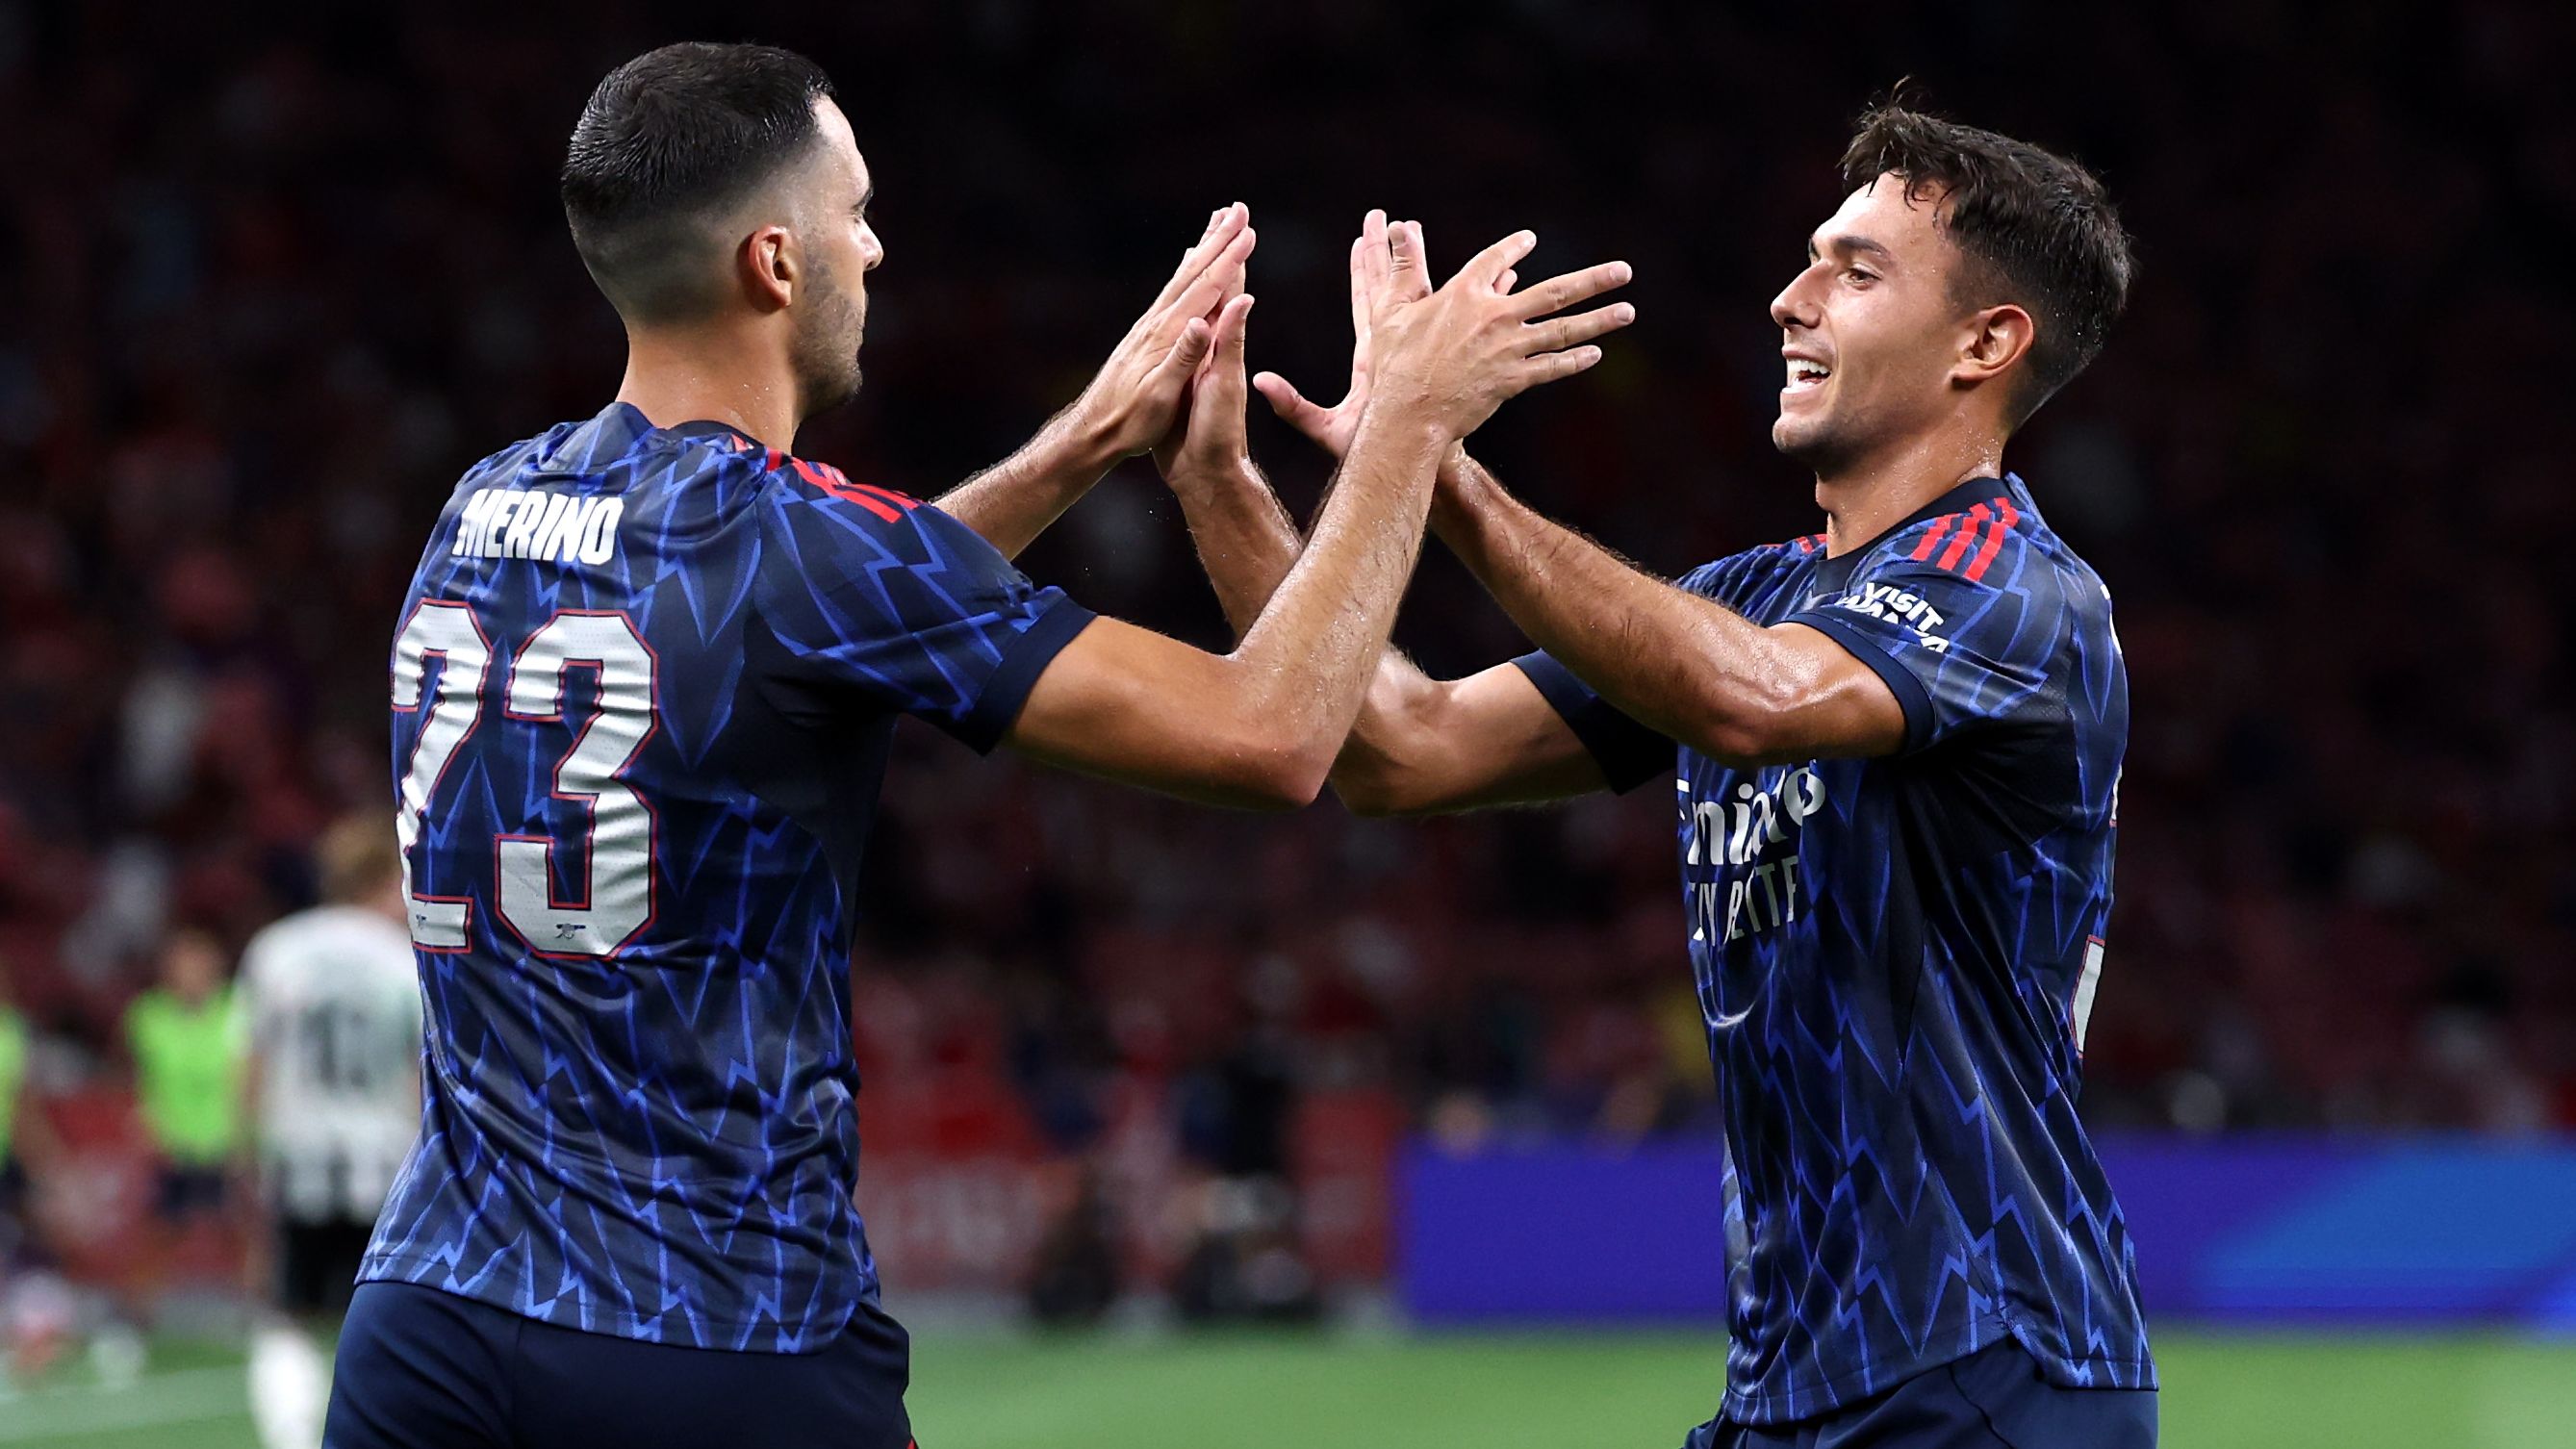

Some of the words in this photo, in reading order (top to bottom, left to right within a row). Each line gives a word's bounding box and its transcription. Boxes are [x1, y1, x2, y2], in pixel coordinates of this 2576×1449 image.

[451, 489, 625, 566] MERINO
[1866, 582, 1945, 632] VISIT
[392, 597, 658, 959] 23
